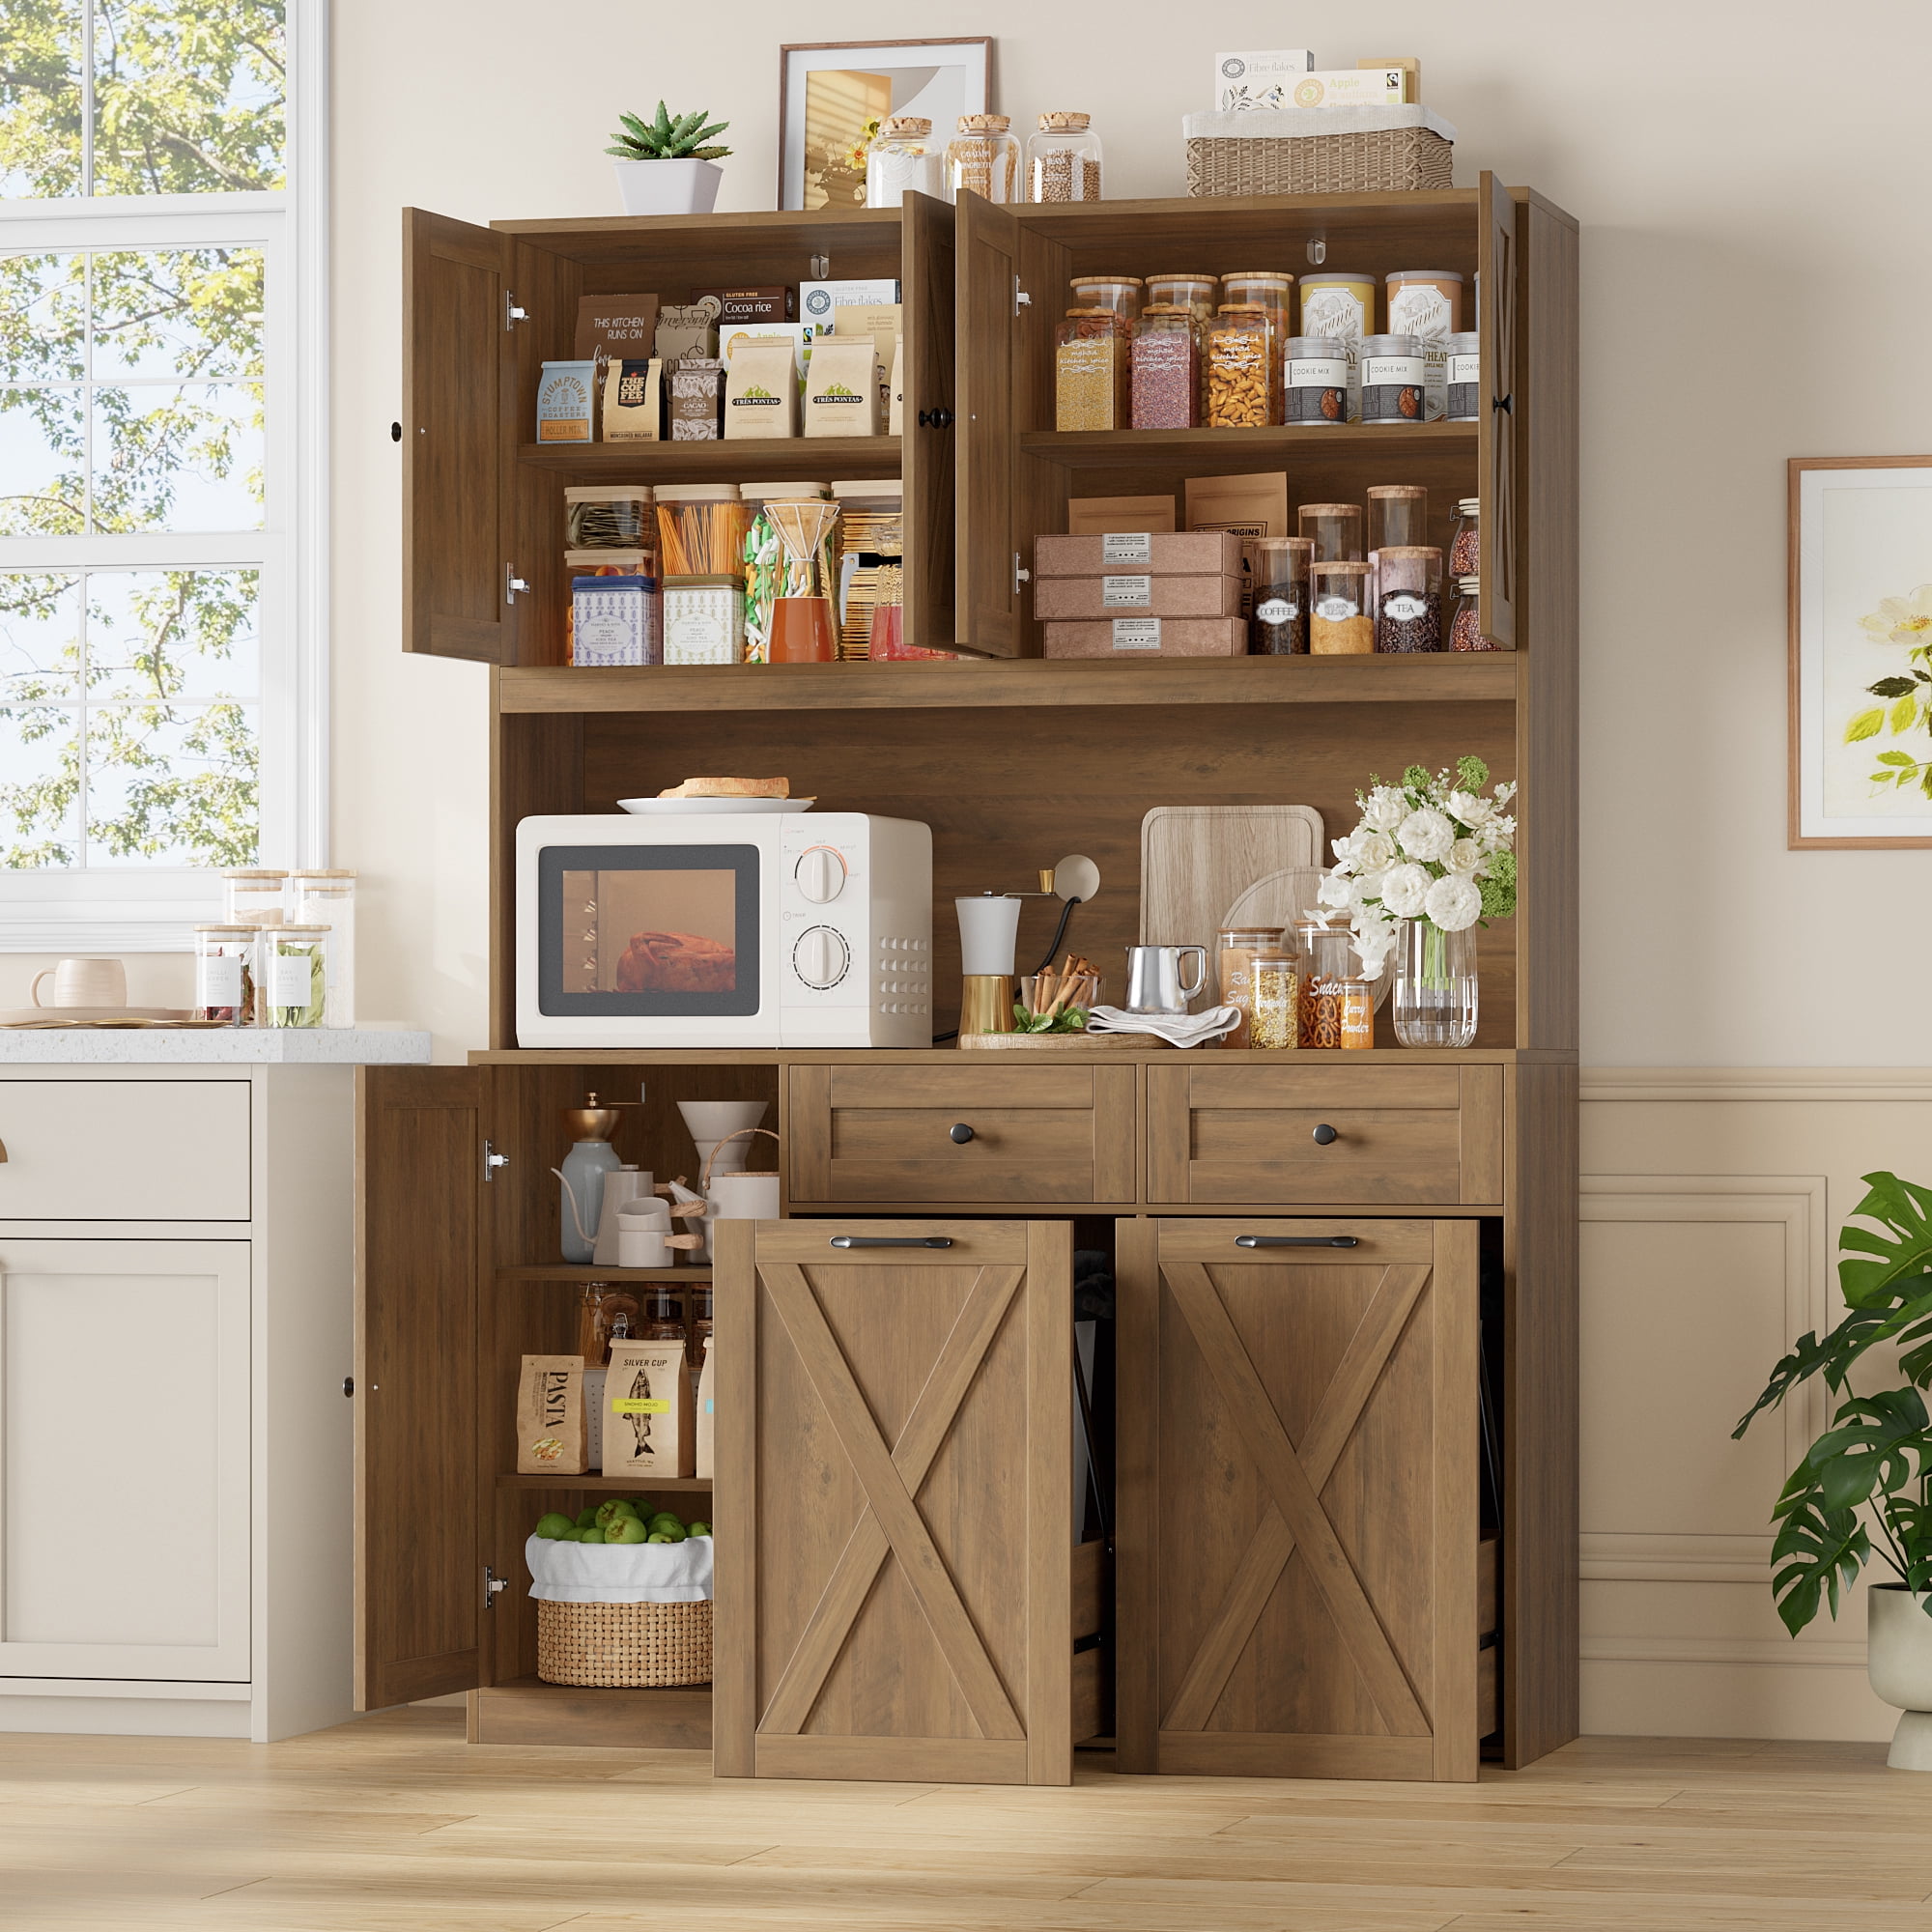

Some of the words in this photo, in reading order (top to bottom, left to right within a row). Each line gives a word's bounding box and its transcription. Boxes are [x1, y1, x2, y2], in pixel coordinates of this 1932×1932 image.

[1329, 77, 1359, 89] Apple
[724, 301, 753, 314] Cocoa
[754, 300, 772, 313] rice
[594, 317, 611, 328] THIS
[611, 316, 645, 327] KITCHEN
[607, 329, 627, 340] RUNS
[629, 328, 643, 339] ON
[1293, 366, 1317, 376] COOKIE
[1318, 366, 1330, 375] MIX
[1371, 365, 1395, 374] COOKIE
[542, 376, 588, 405] STUMPTOWN
[619, 391, 643, 400] FEE
[1260, 608, 1293, 616] COFFEE
[1395, 604, 1415, 613] TEA
[1231, 970, 1250, 986] Ra
[1225, 990, 1250, 1009] Sug
[1341, 1019, 1370, 1035] Powder
[623, 1358, 650, 1368] SILVER
[651, 1358, 668, 1367] CUP
[545, 1372, 569, 1428] PASTA
